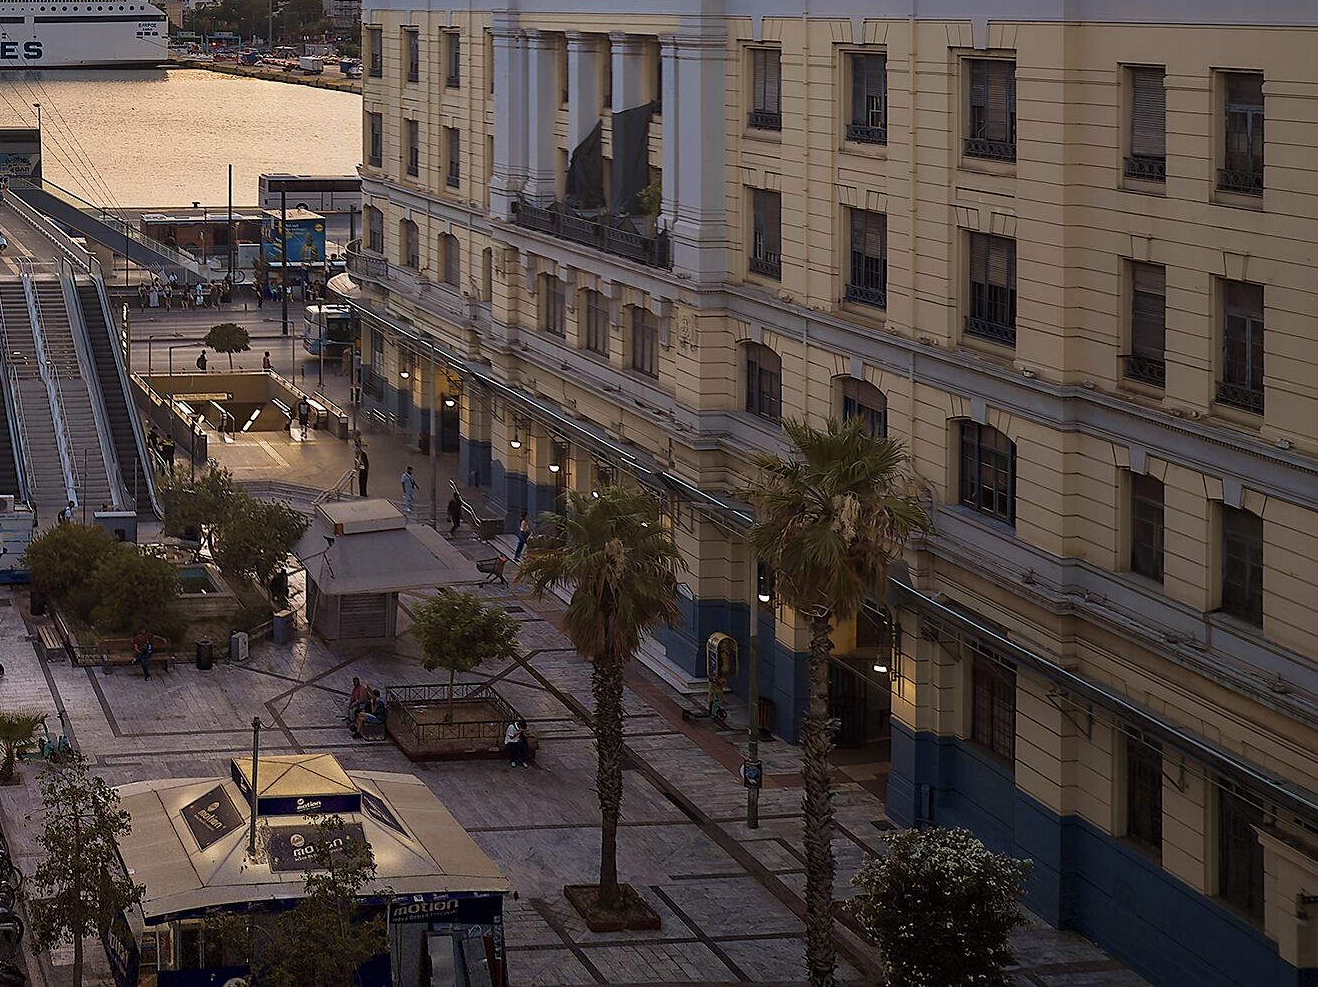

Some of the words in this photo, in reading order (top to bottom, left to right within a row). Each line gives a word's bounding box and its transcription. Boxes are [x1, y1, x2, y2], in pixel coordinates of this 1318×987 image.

[296, 800, 322, 810] motion
[197, 809, 224, 829] motion
[293, 838, 343, 857] mon
[393, 899, 459, 917] motion
